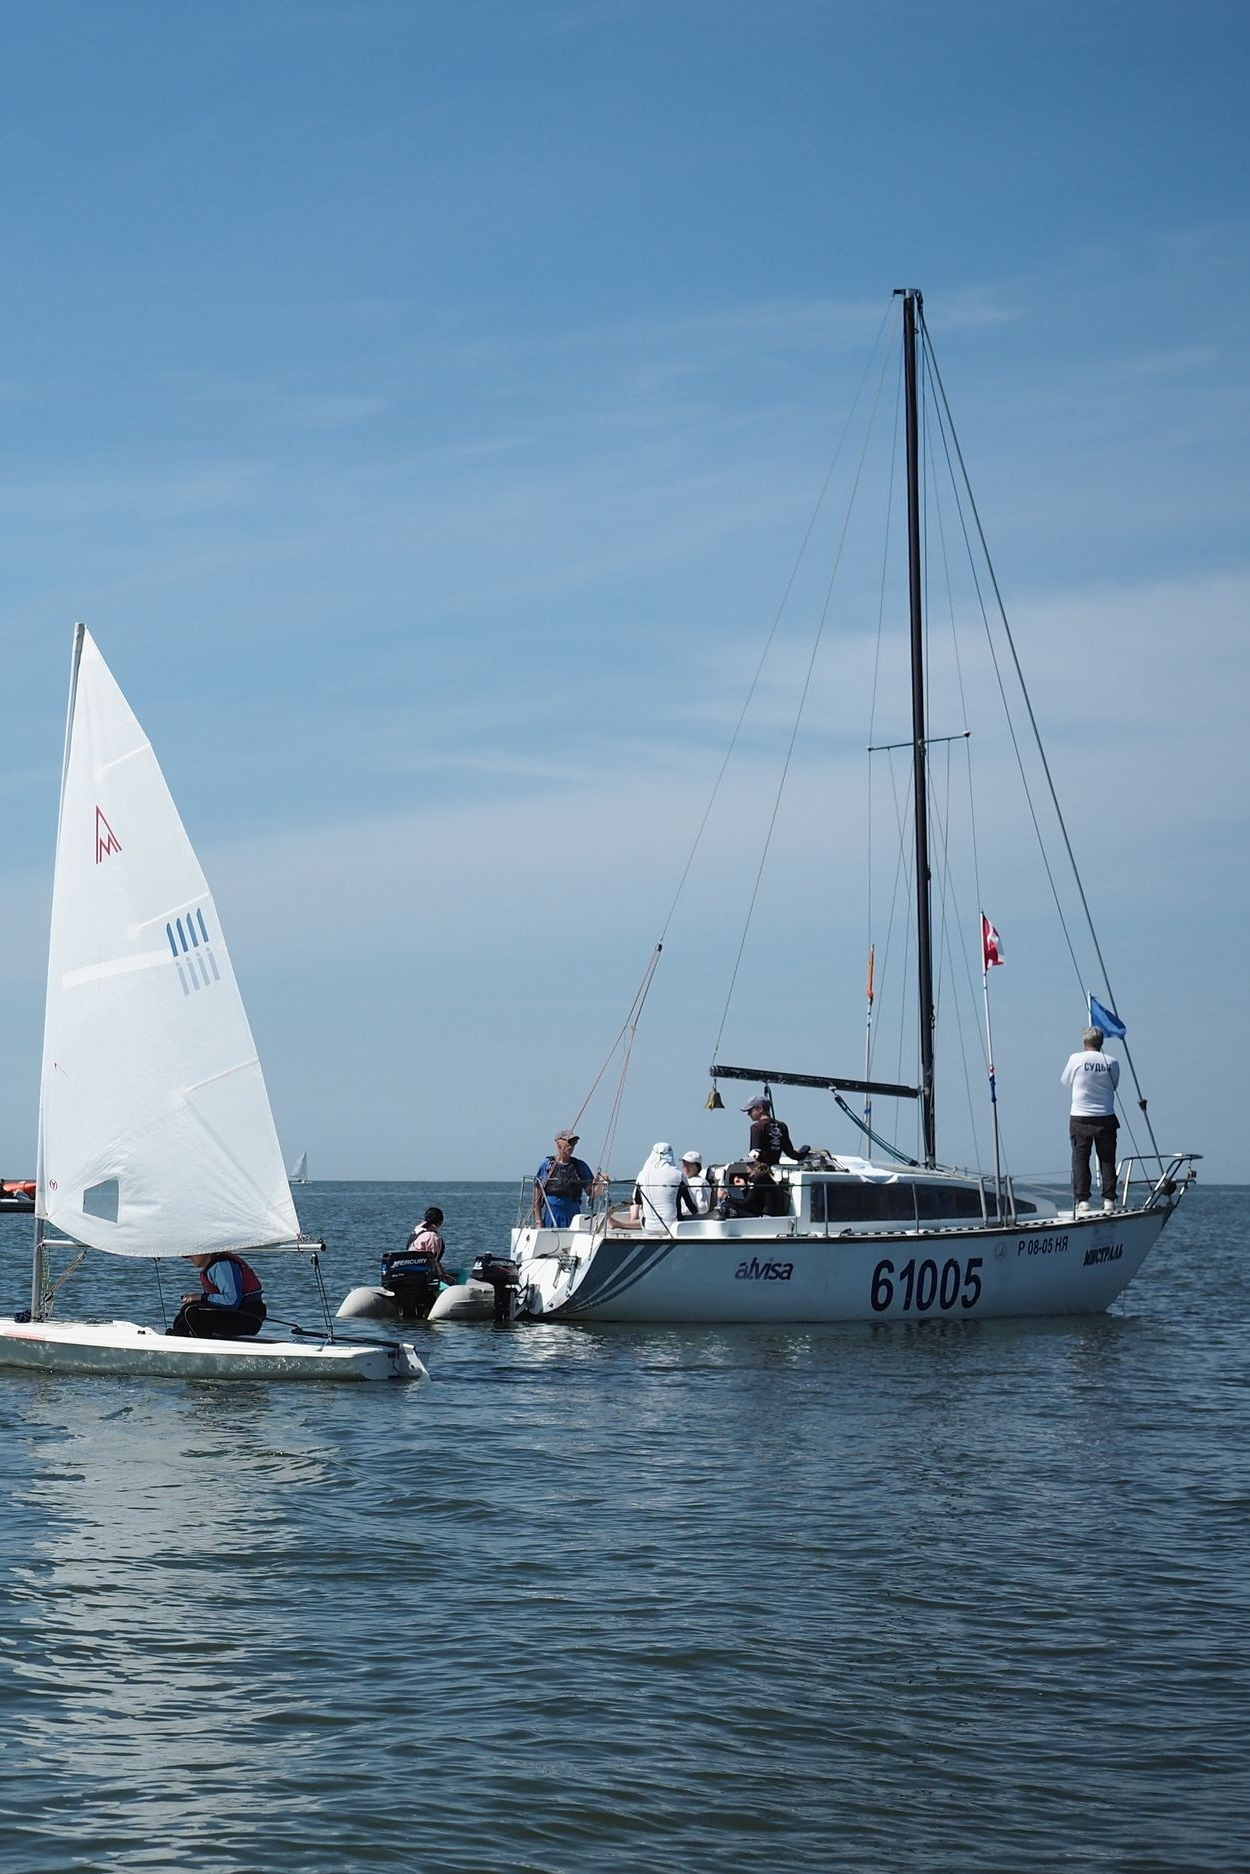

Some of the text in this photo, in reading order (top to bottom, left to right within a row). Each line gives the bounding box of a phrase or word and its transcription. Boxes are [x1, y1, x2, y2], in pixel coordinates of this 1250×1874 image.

[1028, 1238, 1053, 1255] 08-05
[391, 1258, 427, 1269] MERCURY
[871, 1258, 983, 1311] 61005
